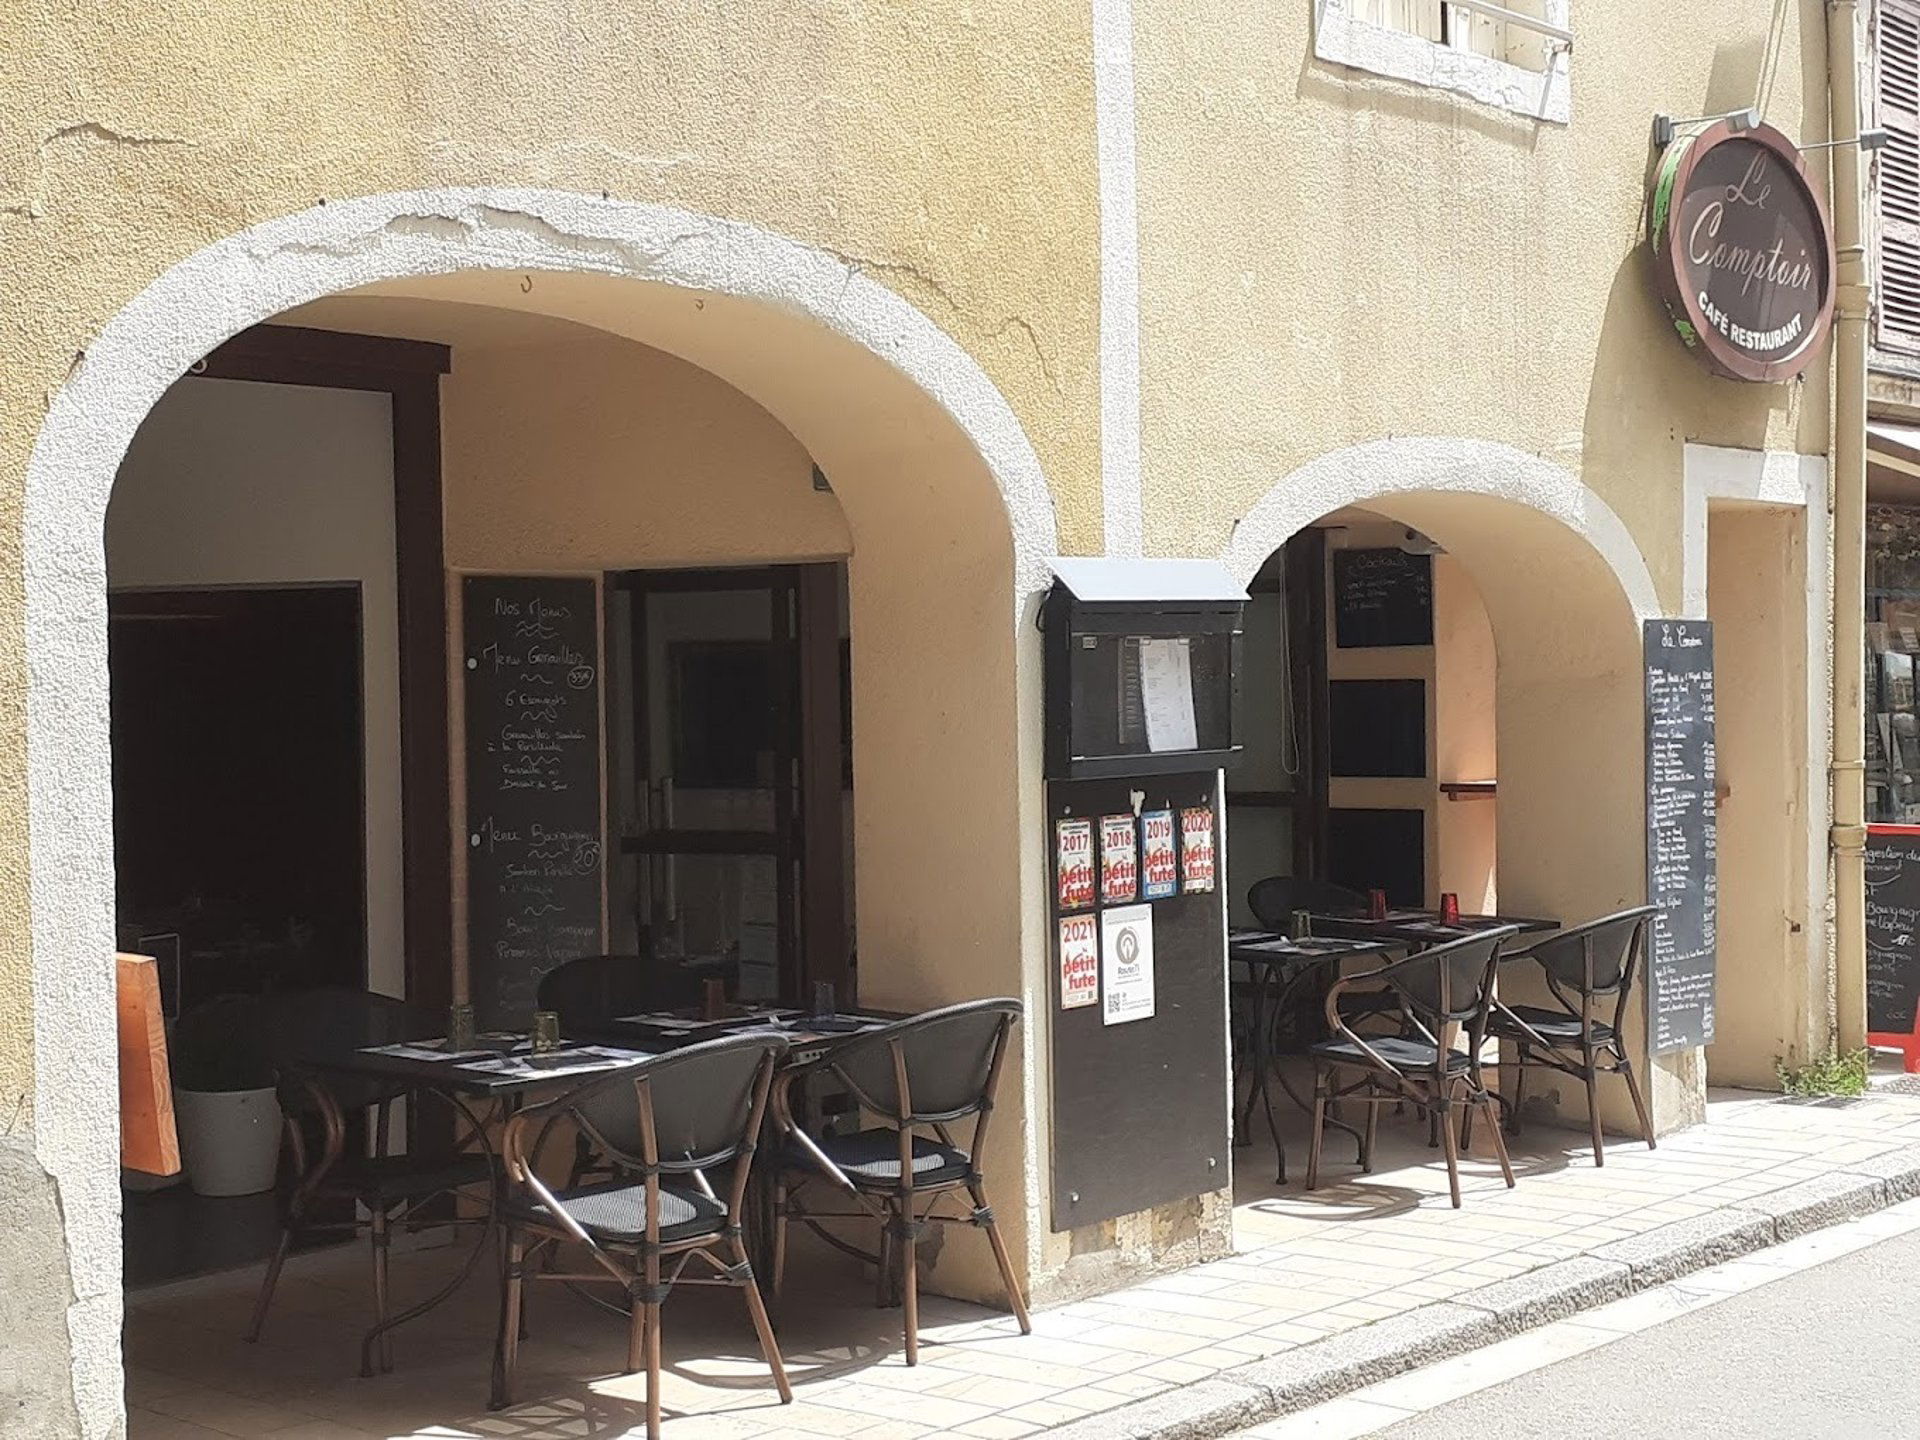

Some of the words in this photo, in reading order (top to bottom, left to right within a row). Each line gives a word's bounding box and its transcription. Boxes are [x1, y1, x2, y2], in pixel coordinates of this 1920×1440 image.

[1725, 150, 1771, 209] Le
[1689, 201, 1811, 297] Comptoir
[1698, 290, 1729, 336] CAFÉ
[1730, 312, 1803, 351] RESTAURANT
[1146, 820, 1170, 839] 2019
[1183, 813, 1211, 832] 2020
[1062, 834, 1089, 852] 2017
[1106, 830, 1132, 848] 2018
[1063, 920, 1094, 943] 2021
